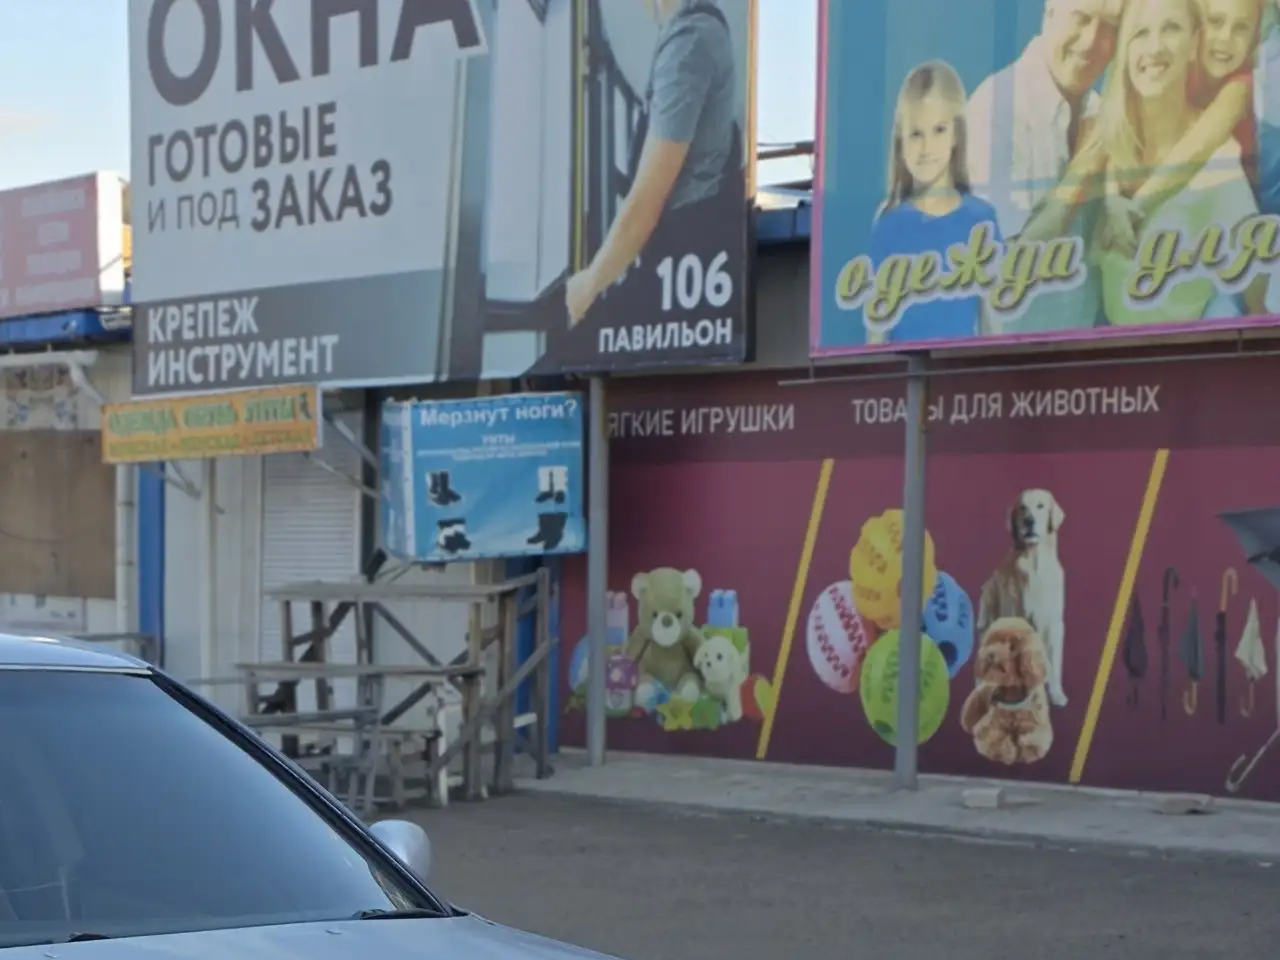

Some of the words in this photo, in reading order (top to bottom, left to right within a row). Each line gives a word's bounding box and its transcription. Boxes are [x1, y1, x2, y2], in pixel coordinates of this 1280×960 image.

[147, 0, 482, 107] ОКНА
[147, 101, 338, 187] ГОТОВЫЕ
[147, 199, 167, 233] И
[176, 188, 240, 232] ПОД
[250, 158, 394, 232] ЗАКАЗ
[656, 250, 733, 312] 106
[838, 221, 1080, 323] одежда
[1126, 212, 1280, 302] для
[147, 296, 260, 344] КРЕПЕЖ
[598, 317, 733, 354] ПАВИЛЬОН
[147, 334, 340, 388] ИНСТРУМЕНТ
[420, 407, 509, 428] Мерзнут
[516, 398, 578, 420] ноги?
[606, 408, 675, 438] ЯГКИЕ
[680, 403, 796, 435] ИГРУШКИ
[851, 395, 944, 425] ТОВАЫ
[948, 391, 1004, 425] ДЛЯ
[1008, 384, 1162, 418] ЖИВОТНЫХ
